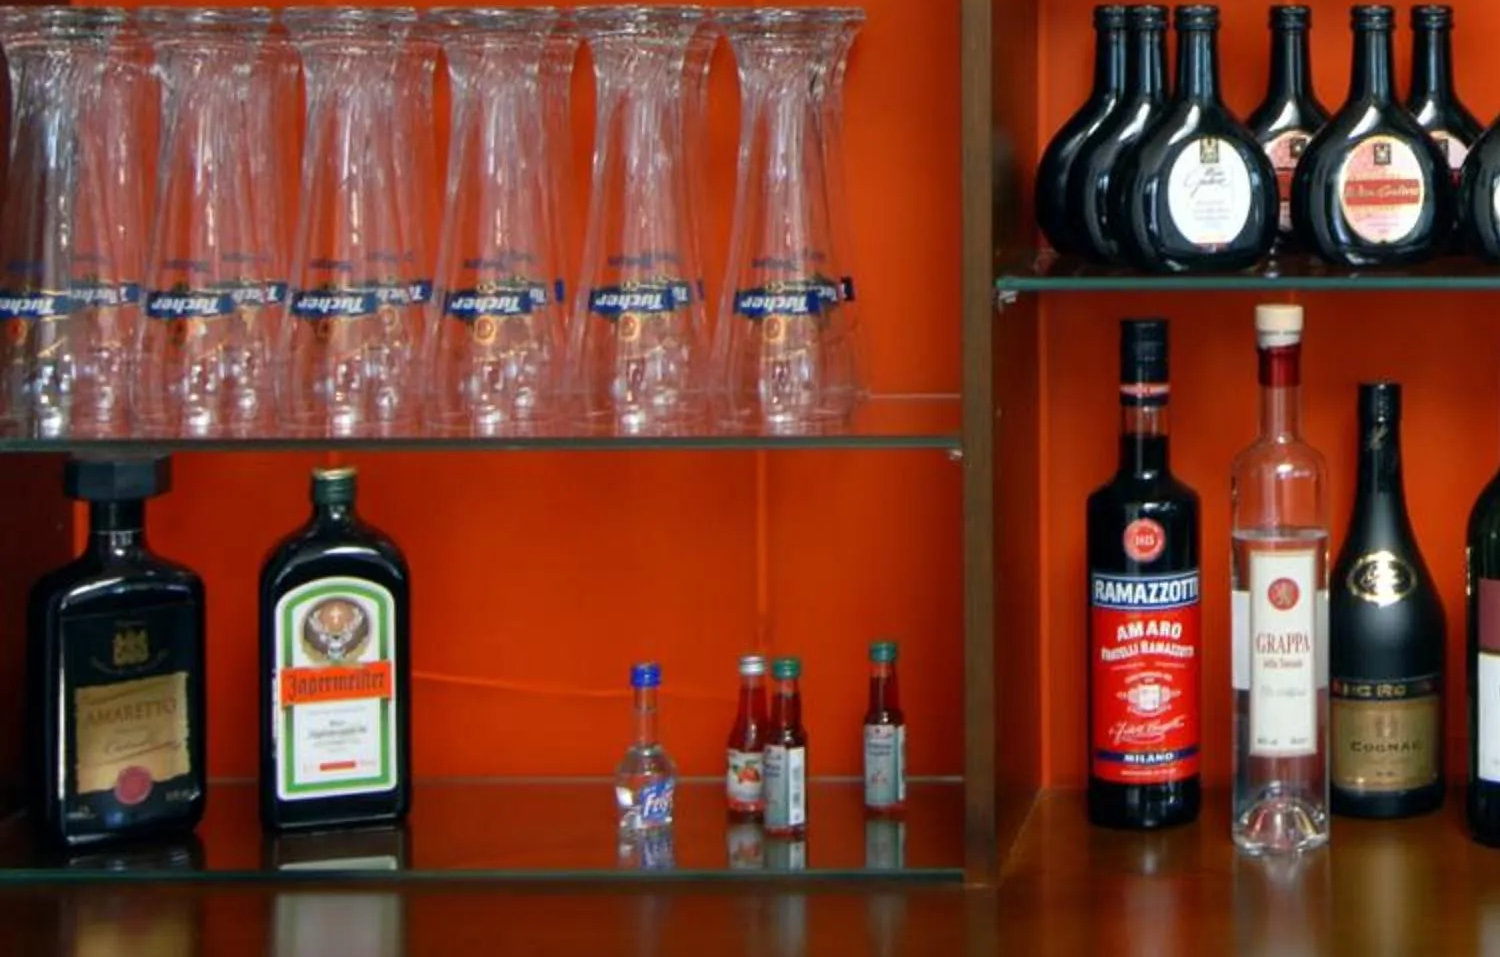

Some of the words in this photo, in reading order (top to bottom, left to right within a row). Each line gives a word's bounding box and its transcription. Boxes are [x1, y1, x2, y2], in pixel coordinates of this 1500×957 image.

[151, 296, 219, 314] Tucher
[297, 295, 365, 314] Tucher
[451, 295, 520, 313] Tucher
[595, 294, 664, 312] Tucher
[741, 294, 809, 313] Tucher
[1095, 577, 1199, 605] RAMAZZOTTI
[1117, 620, 1182, 642] AMARO
[1256, 632, 1311, 655] GRAPPA
[86, 698, 178, 729] AMARETTO
[1350, 740, 1424, 754] COGNAC
[1123, 751, 1176, 764] MILANO
